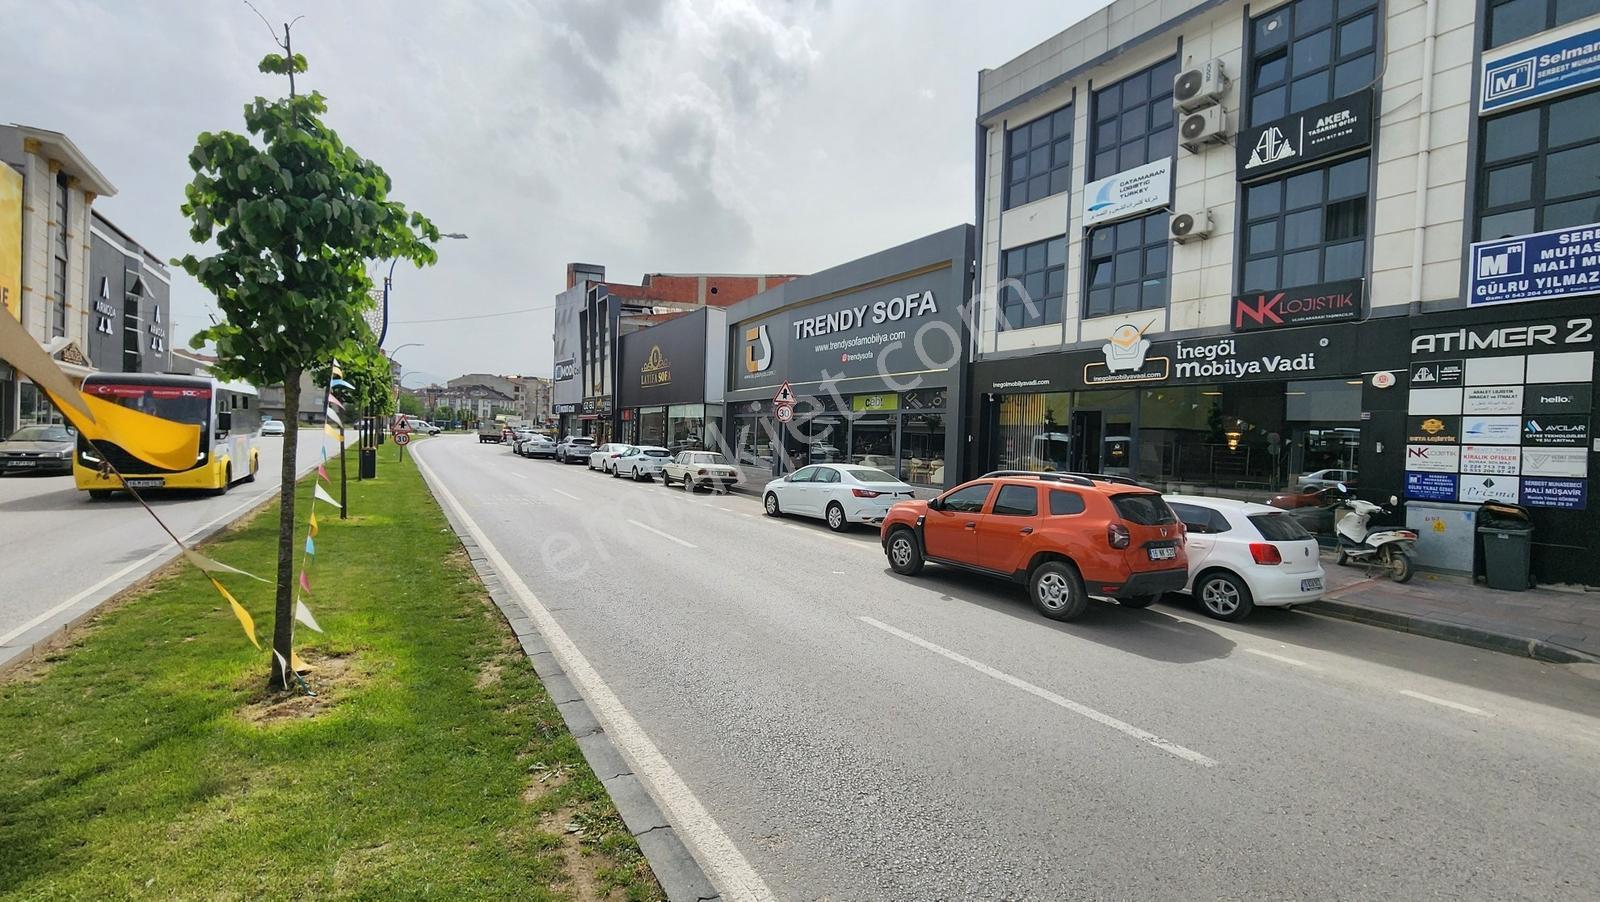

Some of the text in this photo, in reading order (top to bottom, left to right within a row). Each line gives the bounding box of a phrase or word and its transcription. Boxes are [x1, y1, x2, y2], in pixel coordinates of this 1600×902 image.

[1316, 109, 1350, 129] AKER
[1119, 168, 1166, 187] CATAMARAN
[1119, 186, 1149, 199] TURKEY
[1582, 255, 1600, 267] M
[1476, 280, 1529, 296] GÜLRU
[1536, 271, 1600, 289] YILMAZ
[793, 289, 938, 340] TRENDY SOFA
[1235, 292, 1286, 328] NK
[1564, 318, 1593, 344] 2
[814, 329, 906, 353] www.trendysofamobilya.com
[847, 351, 874, 362] trendysofa
[1262, 353, 1316, 372] Vadi
[779, 409, 790, 418] 30
[1545, 424, 1586, 432] AVCILAR
[397, 435, 407, 443] 30
[1409, 447, 1429, 459] NK
[1545, 487, 1581, 496] MÜŞAVİR
